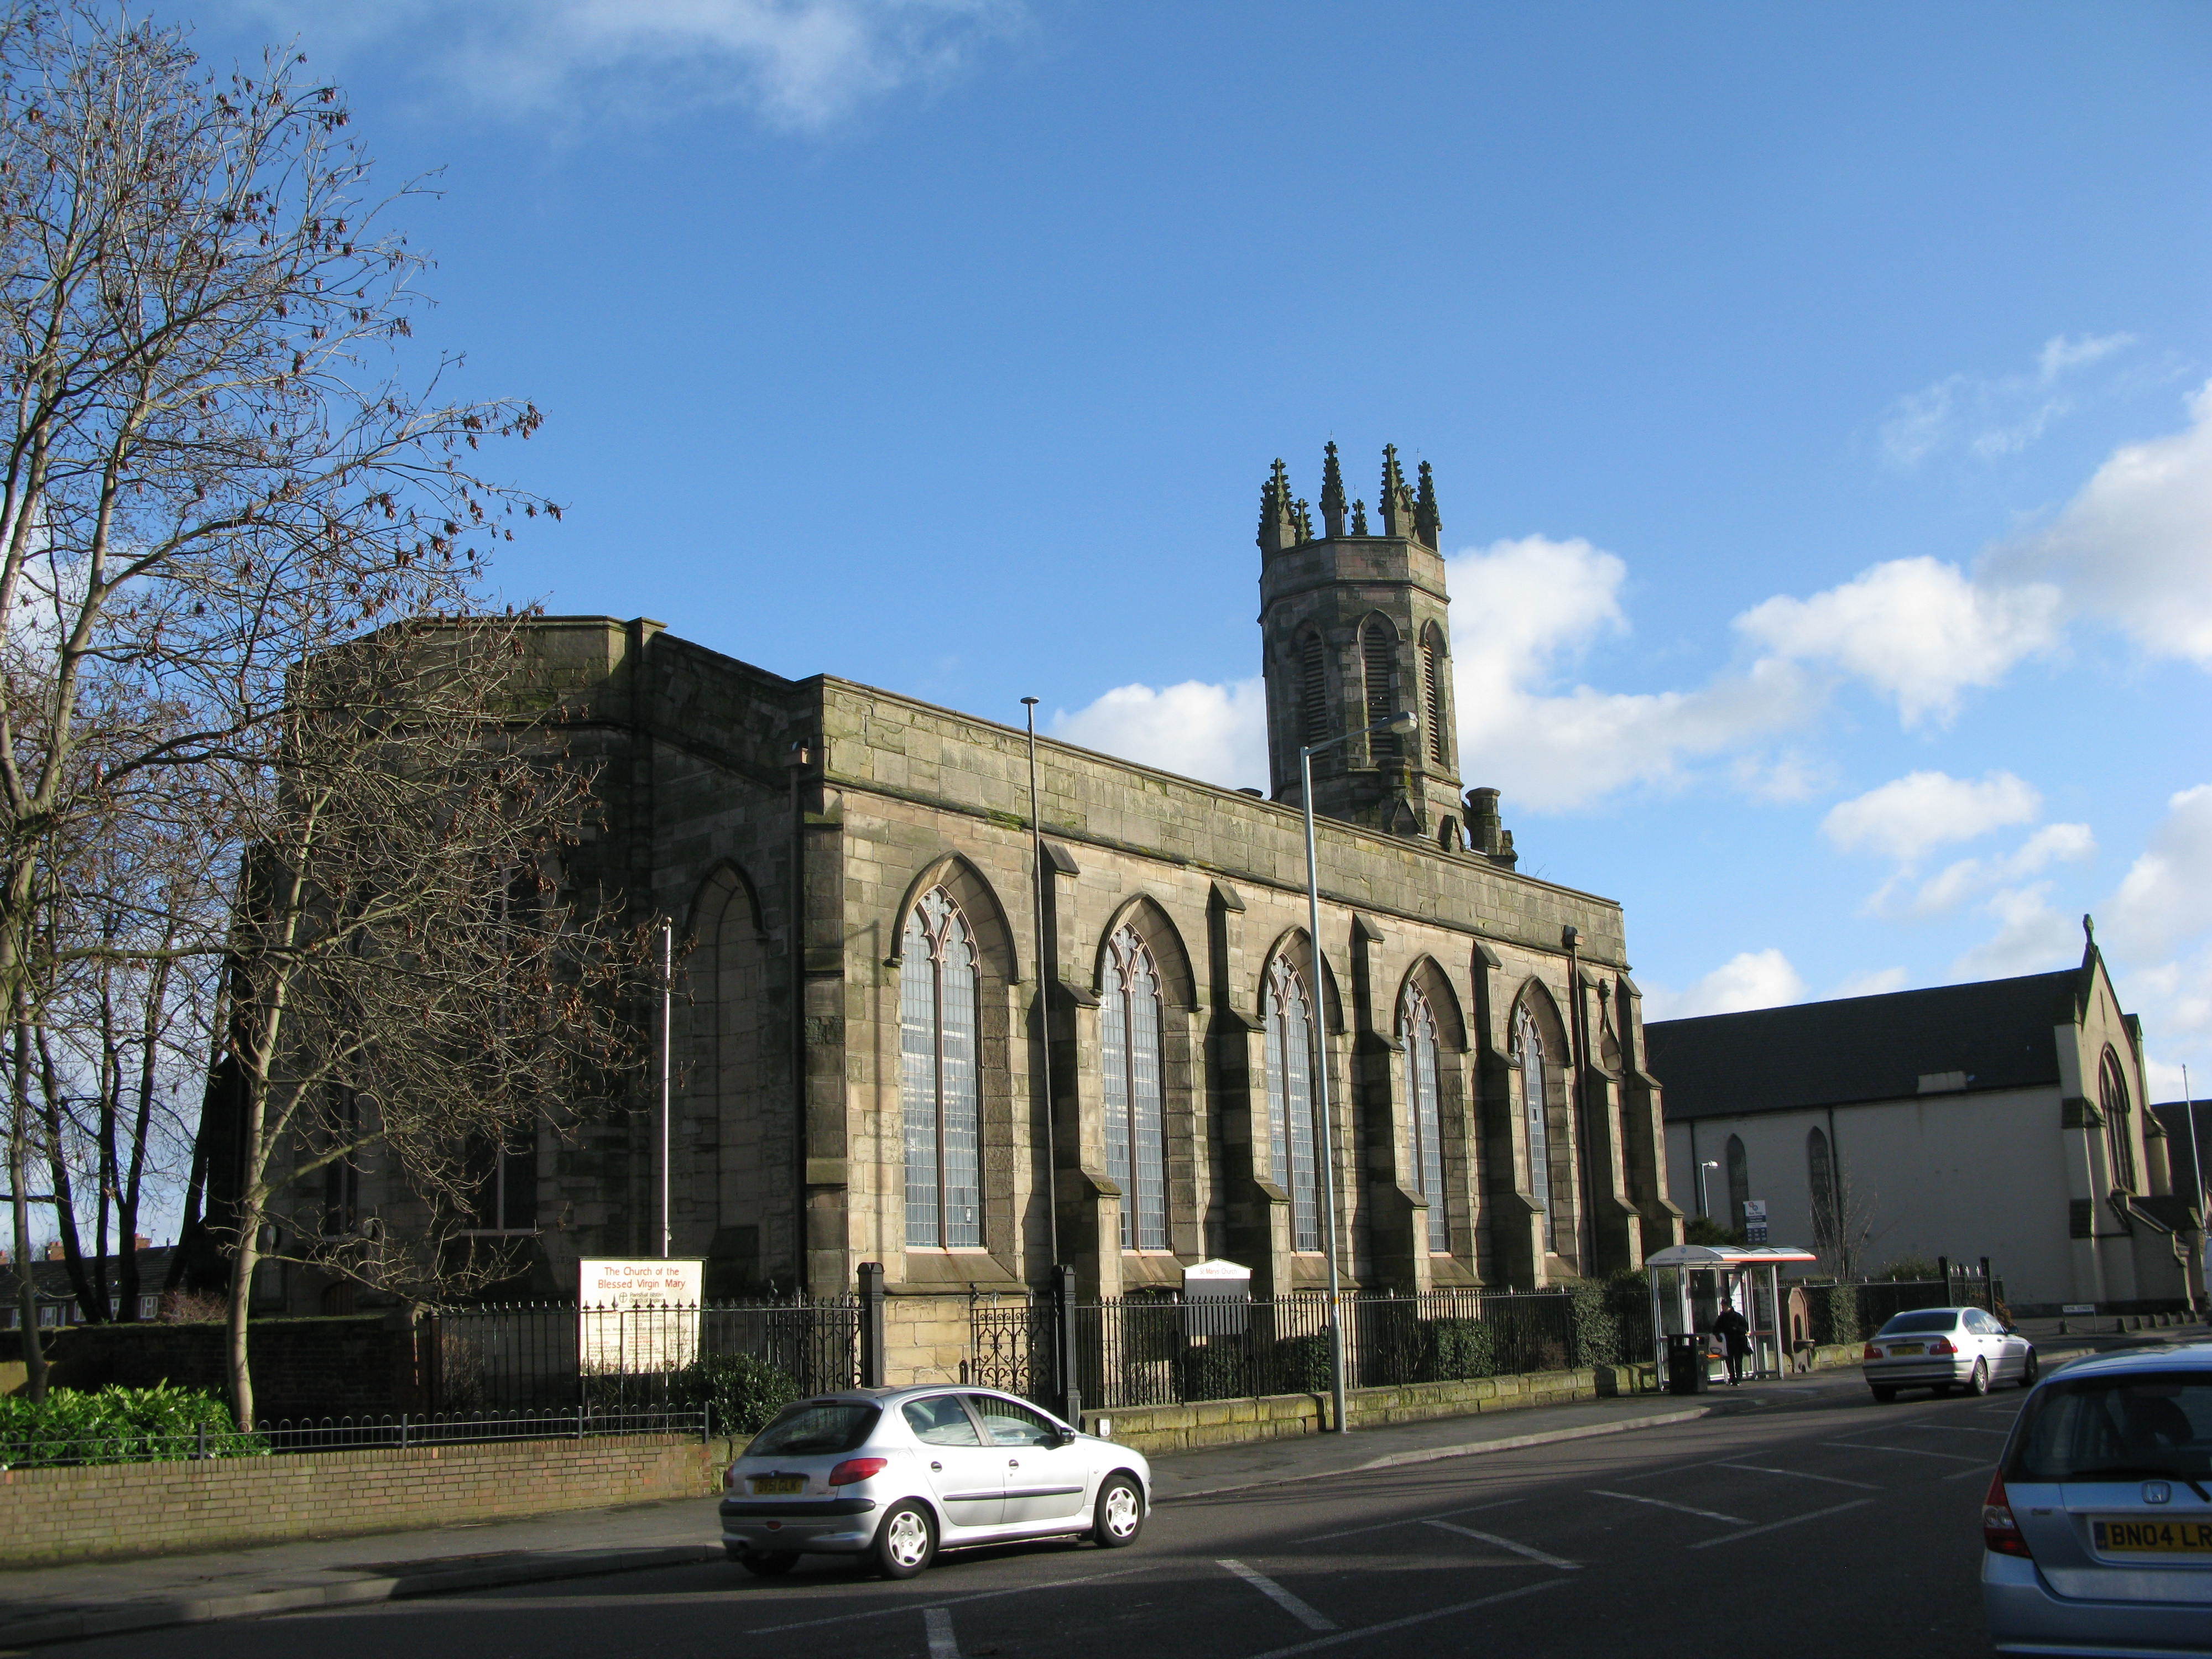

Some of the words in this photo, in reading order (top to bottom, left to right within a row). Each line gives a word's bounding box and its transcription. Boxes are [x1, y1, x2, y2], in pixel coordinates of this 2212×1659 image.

[604, 1267, 620, 1276] The
[624, 1266, 652, 1276] Church
[655, 1267, 663, 1276] of
[666, 1267, 680, 1276] the
[598, 1279, 632, 1288] Blessed
[637, 1279, 659, 1291] Virgin
[665, 1279, 686, 1290] Mary
[2110, 1524, 2174, 1546] BN04
[2181, 1524, 2212, 1547] LR
